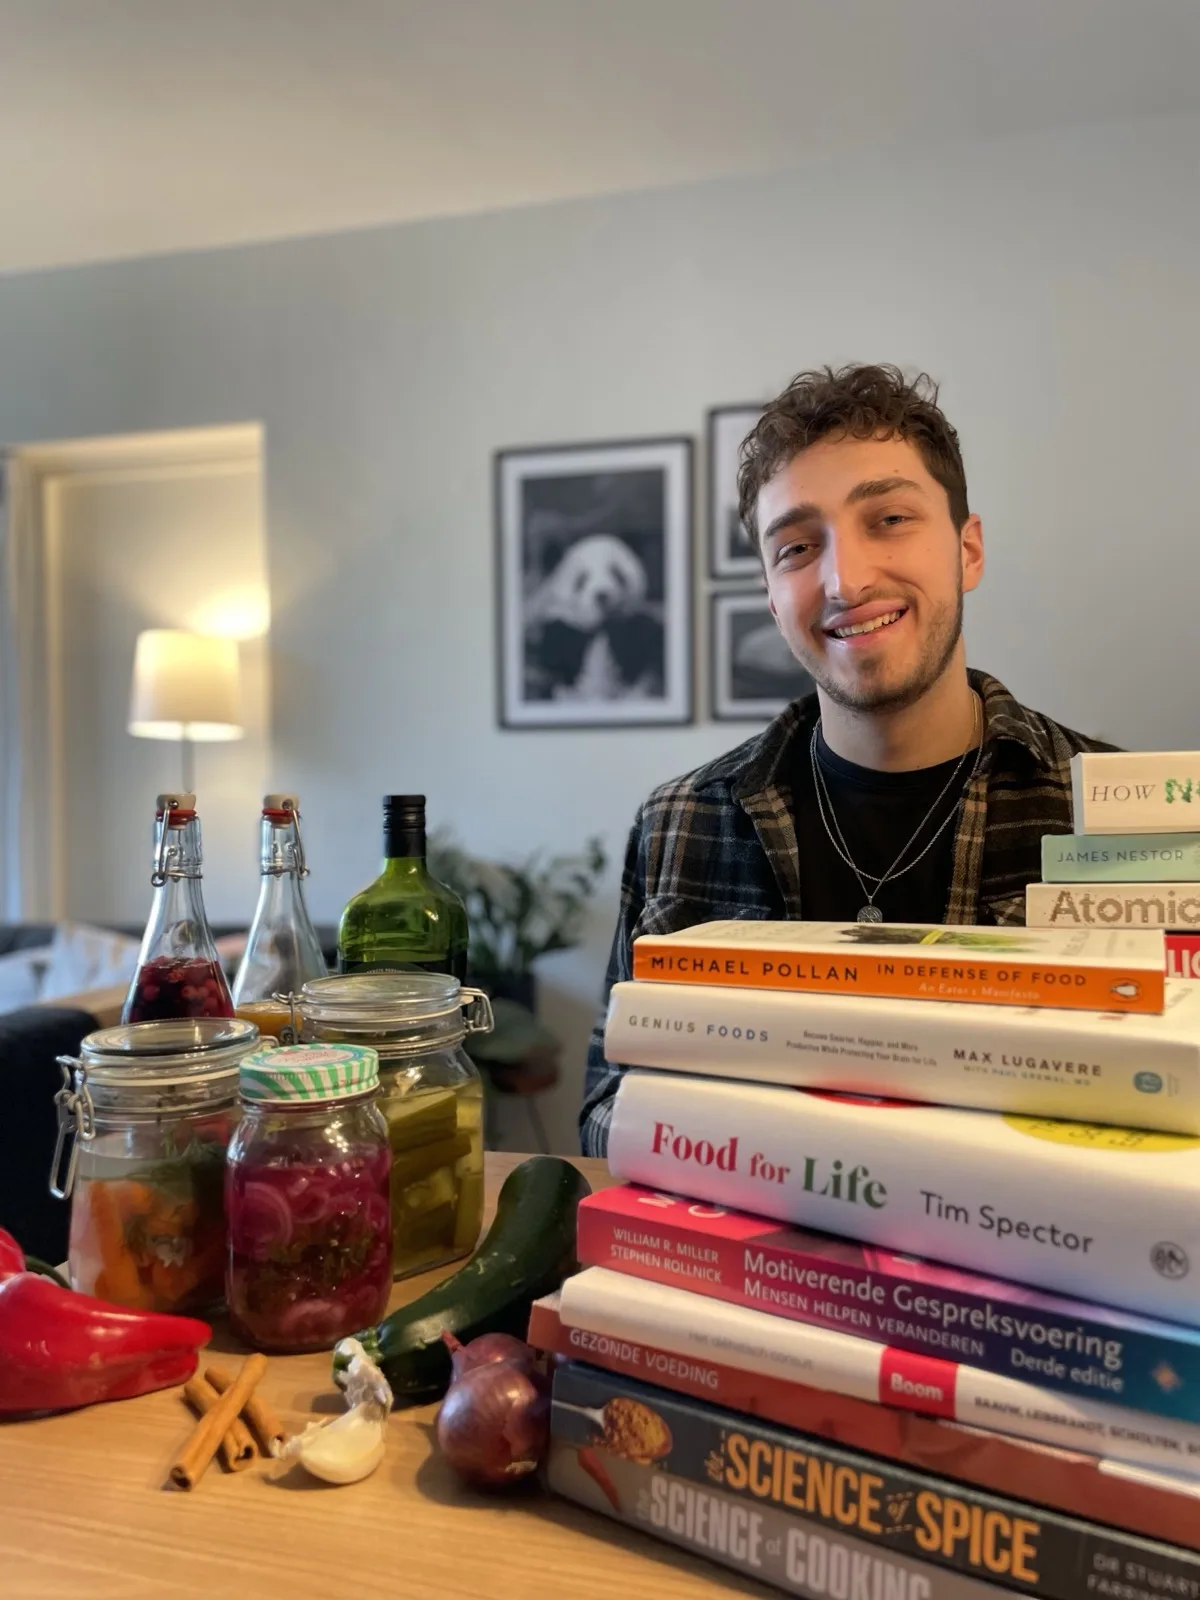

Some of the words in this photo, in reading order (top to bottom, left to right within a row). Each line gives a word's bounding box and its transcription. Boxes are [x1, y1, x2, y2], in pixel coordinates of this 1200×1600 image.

[1092, 784, 1156, 802] HOW
[1165, 777, 1200, 804] N
[1058, 850, 1110, 863] JAMES
[1117, 849, 1184, 862] NESTOR
[1049, 889, 1200, 925] Atomic
[651, 956, 749, 975] MICHAEL
[762, 961, 858, 982] POLLAN
[877, 963, 895, 976] IN
[904, 966, 989, 981] DEFENSE
[997, 971, 1022, 983] OF
[1031, 972, 1087, 987] FOOD
[629, 1015, 696, 1033] GENIUS
[706, 1024, 768, 1042] FOODS
[953, 1048, 993, 1064] MAX
[1001, 1054, 1102, 1077] LUGAVERE
[651, 1120, 739, 1172] Food
[749, 1151, 791, 1184] for
[803, 1155, 888, 1209] Life
[920, 1189, 969, 1224] Tim
[978, 1204, 1094, 1253] Spector
[610, 1243, 660, 1268] STEPHEN
[664, 1257, 722, 1283] ROLLNICK
[613, 1226, 660, 1249] WILLIAM
[663, 1239, 673, 1253] R.
[676, 1242, 719, 1264] MILLER
[743, 1248, 885, 1304] Motiverende
[893, 1284, 1124, 1370] Gespreksvoering
[743, 1277, 808, 1312] MENSEN
[813, 1299, 872, 1328] HELPEN
[876, 1315, 985, 1357] VERANDEREN
[569, 1328, 641, 1364] GEZONDE
[645, 1354, 720, 1389] VOEDING
[1010, 1347, 1066, 1379] Derde
[1070, 1365, 1124, 1394] editie
[890, 1371, 944, 1401] Boom
[651, 1475, 764, 1568] SCIENCE
[725, 1432, 884, 1535] SCIENCE
[914, 1490, 1041, 1584] SPICE
